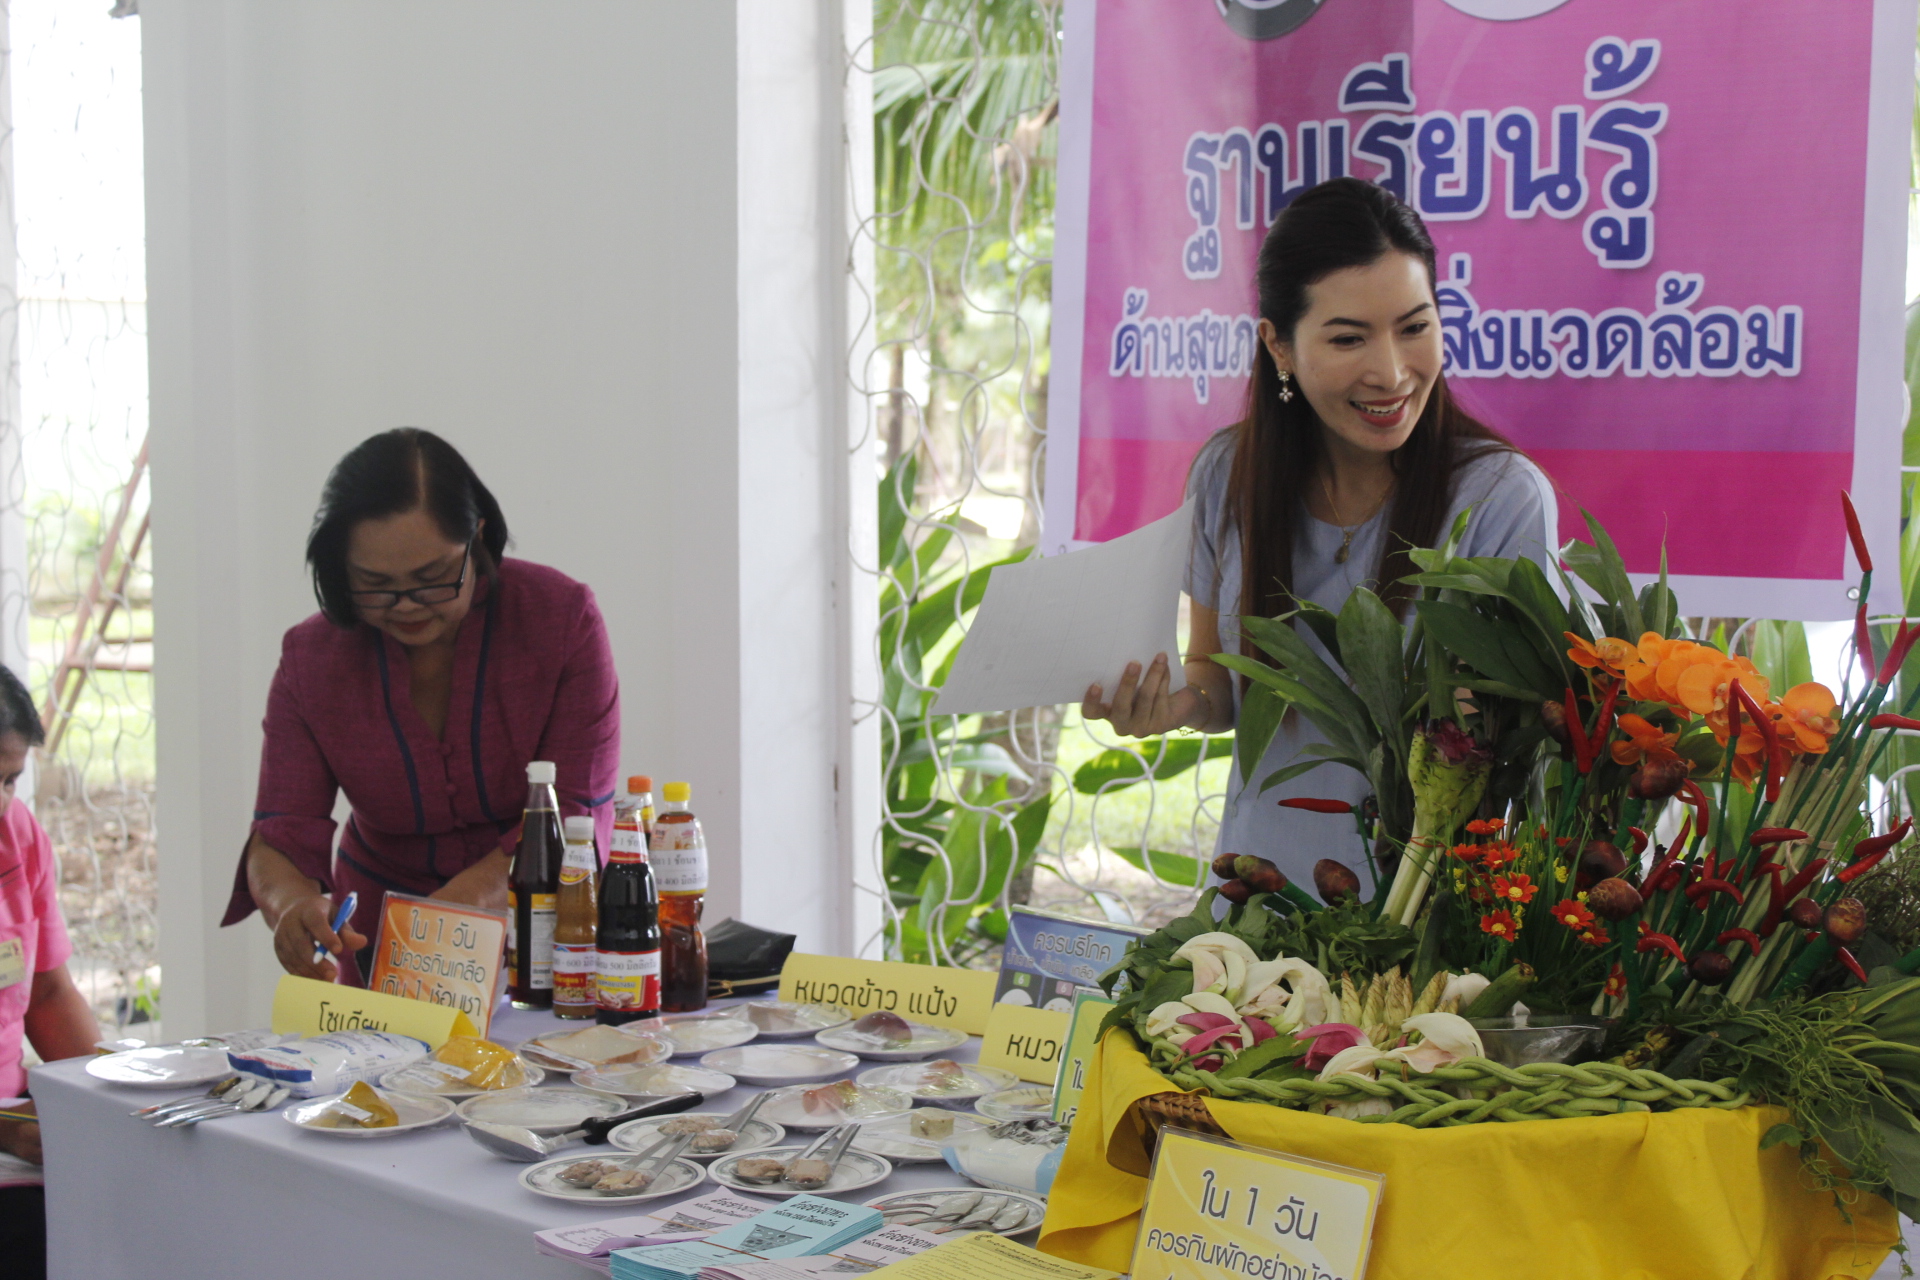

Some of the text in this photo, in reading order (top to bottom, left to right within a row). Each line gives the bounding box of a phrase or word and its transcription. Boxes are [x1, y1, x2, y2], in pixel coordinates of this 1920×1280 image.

[1185, 42, 1662, 273] ฐานเรียนรู้
[1112, 293, 1259, 395] ด้านสุขภ
[410, 908, 477, 950] ใน 1 วัน
[389, 941, 486, 984] ไม่ควรกินเกลือ
[794, 978, 958, 1018] หมวดข้าว แป้ง
[1006, 1034, 1063, 1063] หมว
[1200, 1170, 1319, 1242] ใน 1 วัน
